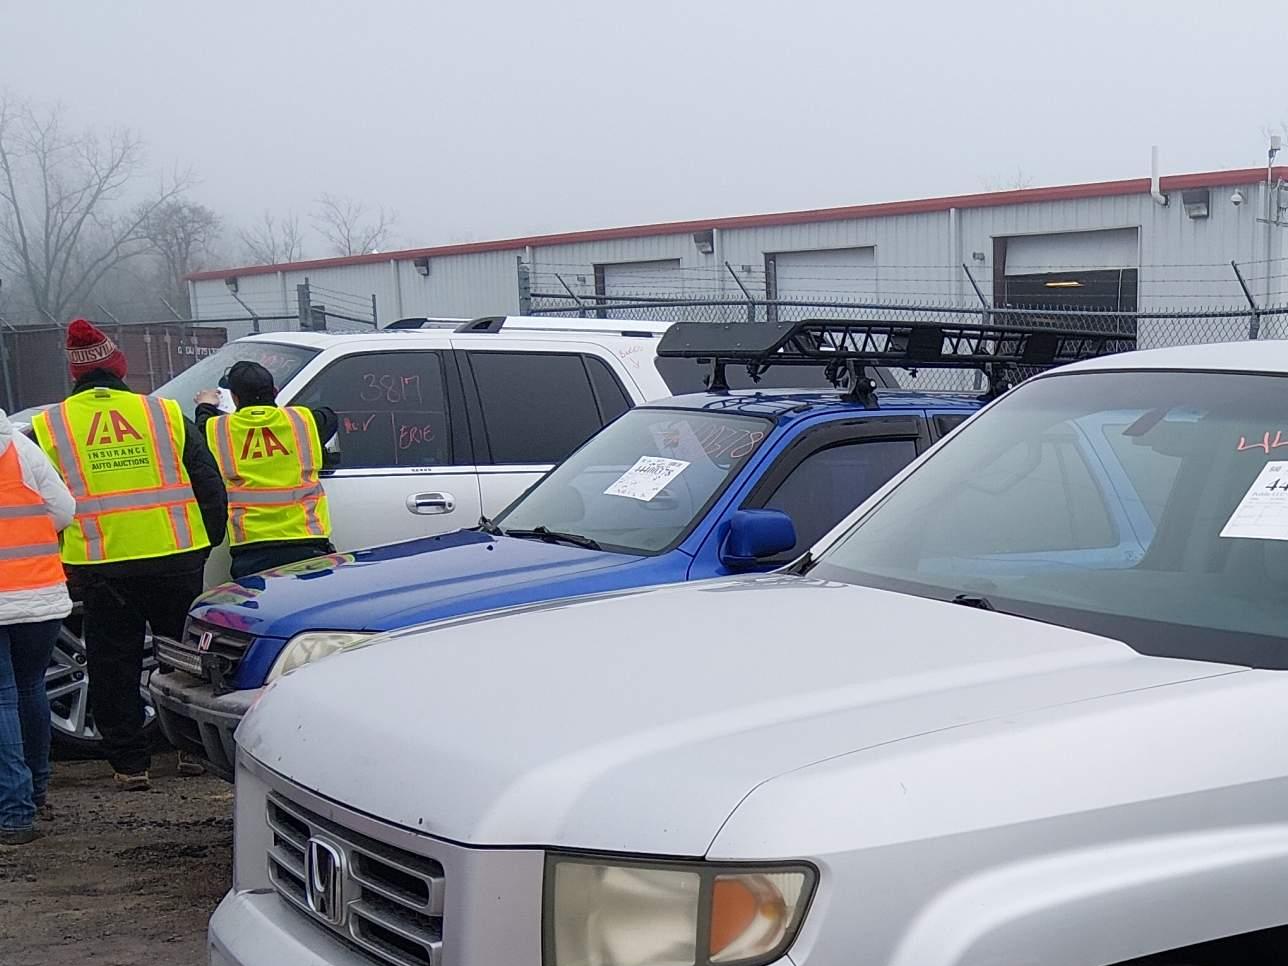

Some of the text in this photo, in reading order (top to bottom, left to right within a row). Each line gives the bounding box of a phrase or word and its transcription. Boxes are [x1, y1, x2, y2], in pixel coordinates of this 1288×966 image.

[86, 409, 144, 446] IAA
[88, 446, 146, 460] INSURANCE
[240, 426, 290, 460] IAA
[91, 457, 150, 471] AUTO AUCTIONS
